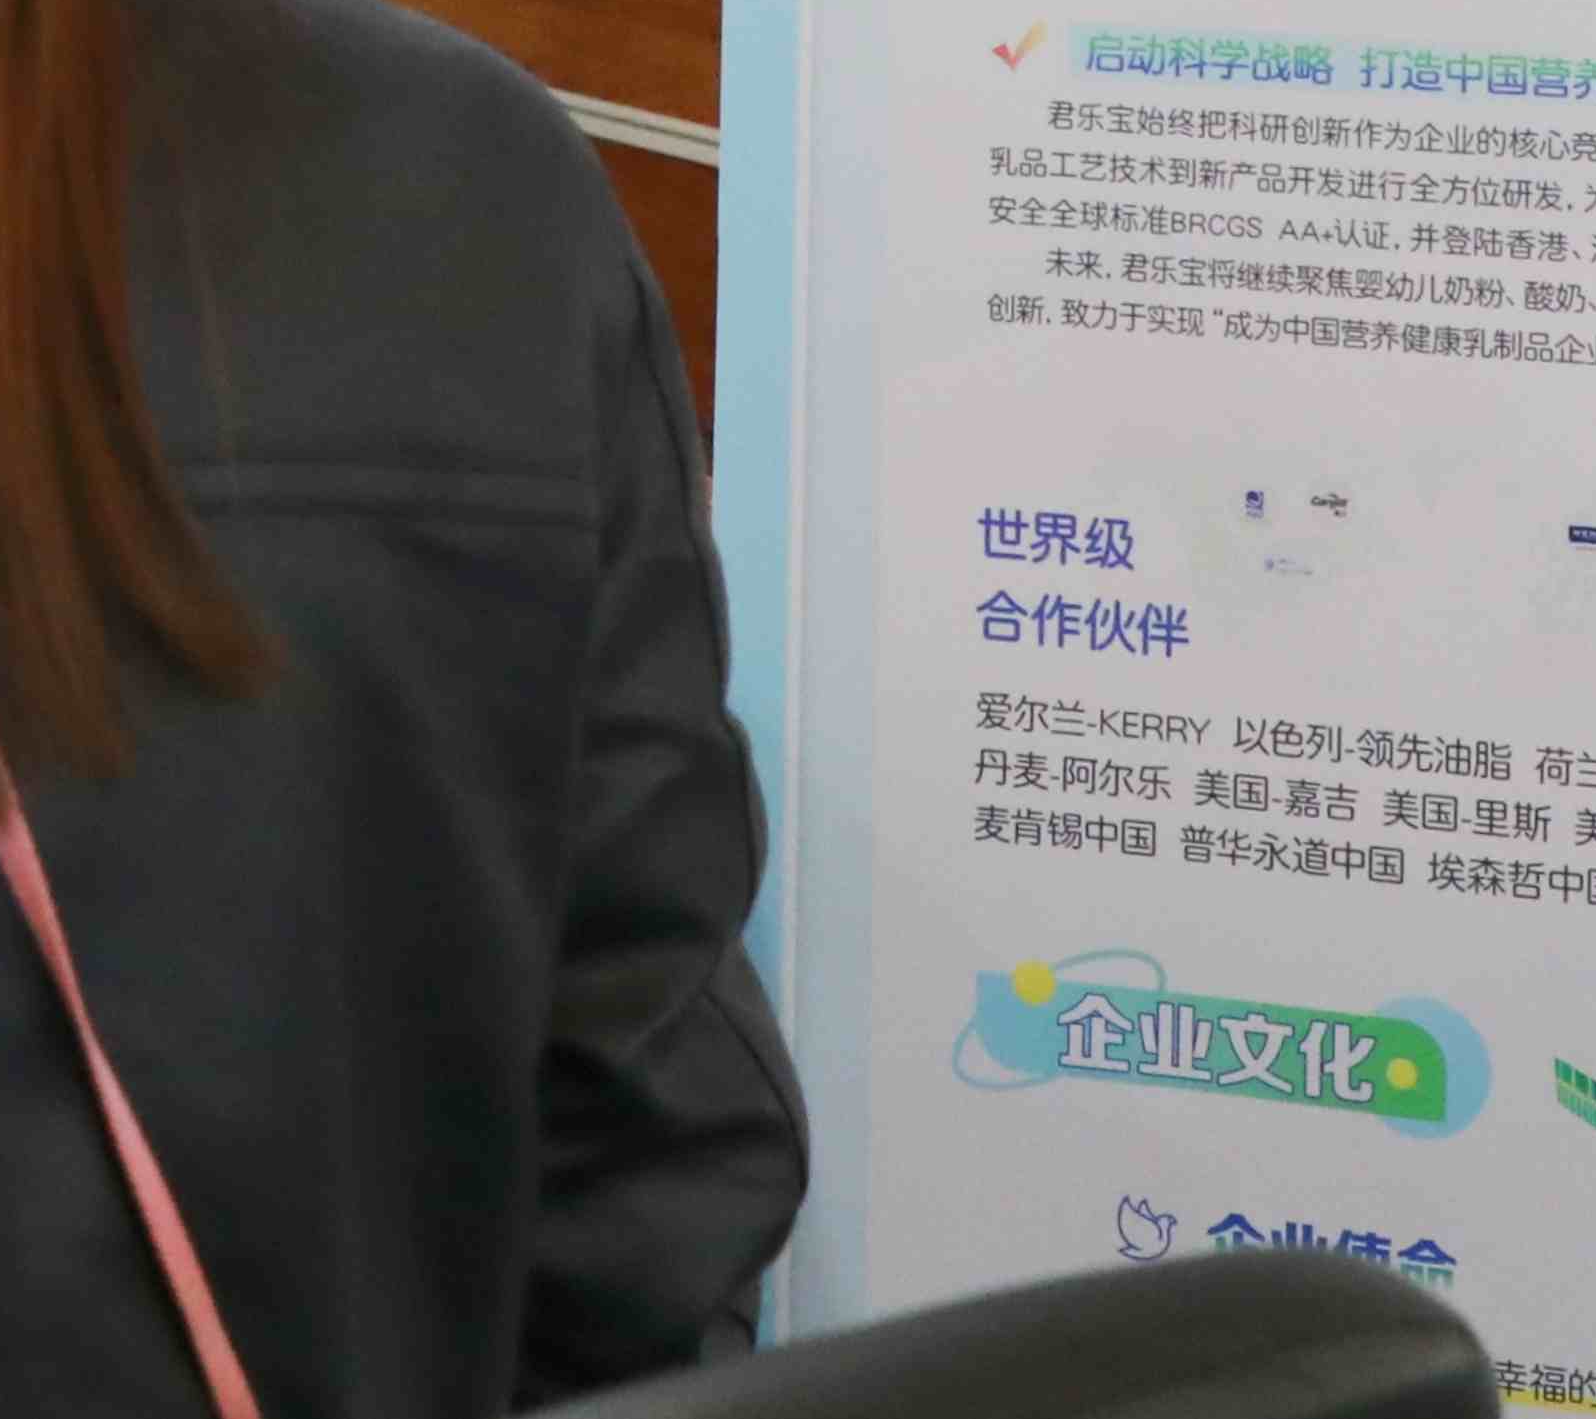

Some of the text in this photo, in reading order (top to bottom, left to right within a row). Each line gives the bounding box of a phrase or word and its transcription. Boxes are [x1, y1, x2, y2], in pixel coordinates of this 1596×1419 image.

[1084, 34, 1335, 87] 启动科学战略
[977, 507, 1135, 571] 世界级
[975, 589, 1191, 658] 合作伙伴
[975, 691, 1211, 746] 爱尔兰-KERRY
[1233, 716, 1513, 781] 以色列-领先油脂
[974, 747, 1173, 802] 丹麦-阿尔乐
[1195, 769, 1360, 822] 美国-嘉吉
[1382, 788, 1552, 842] 美国-里斯
[974, 805, 1158, 858] 麦肯锡中国
[1179, 824, 1405, 885] 普华永道中国
[1056, 991, 1378, 1104] 企业文化
